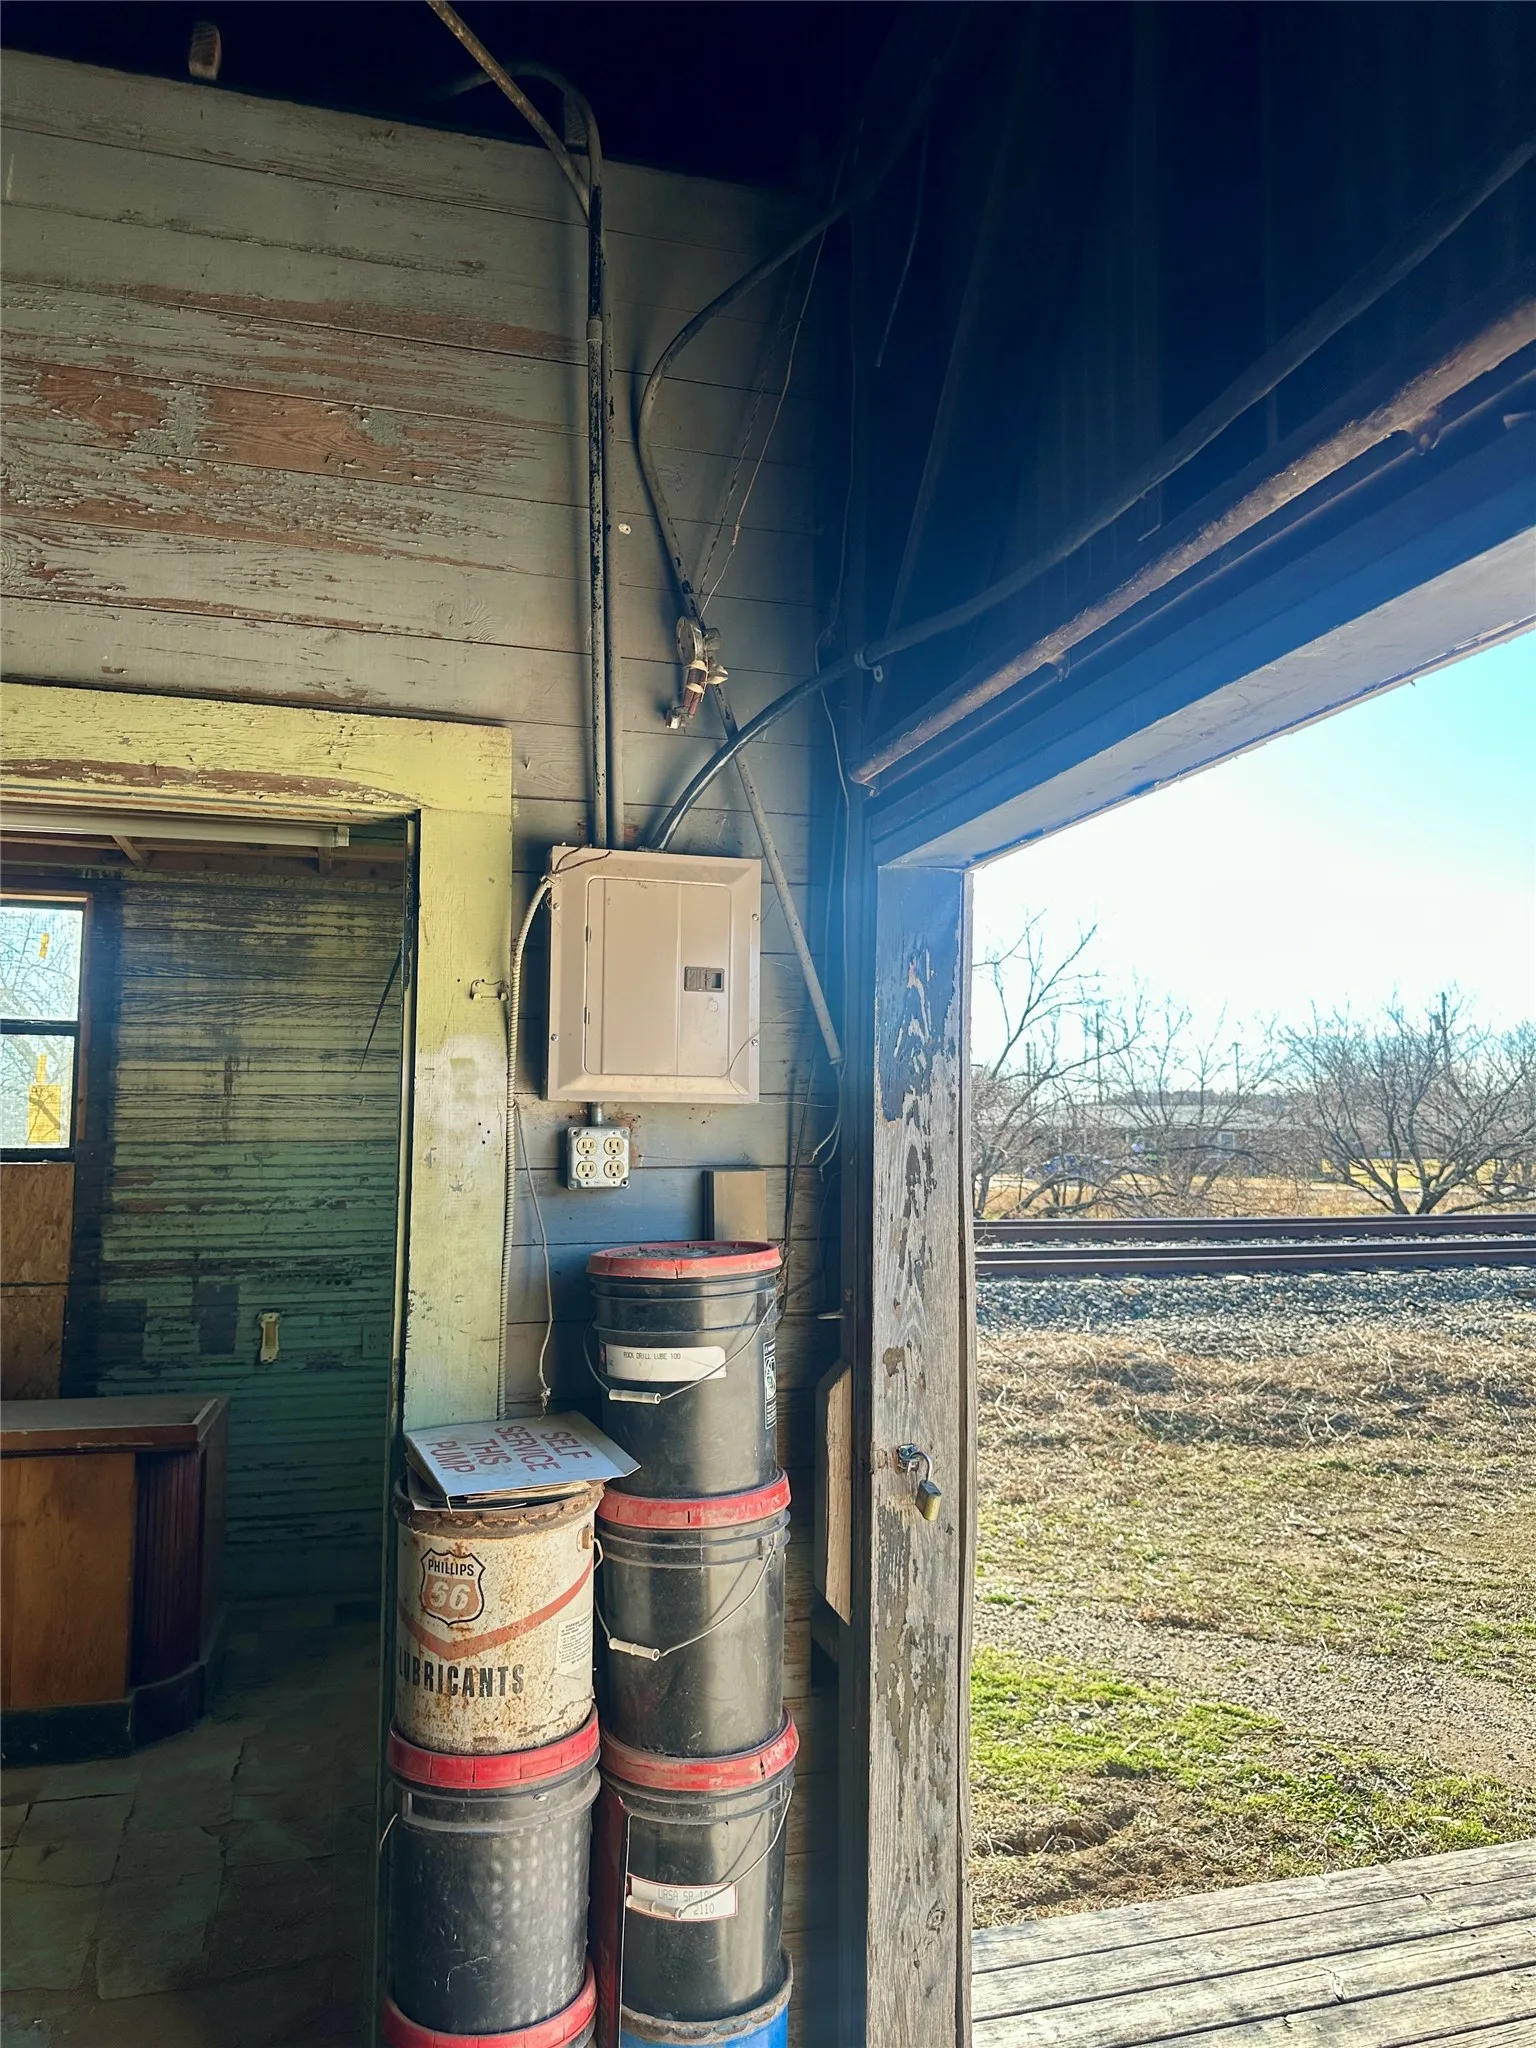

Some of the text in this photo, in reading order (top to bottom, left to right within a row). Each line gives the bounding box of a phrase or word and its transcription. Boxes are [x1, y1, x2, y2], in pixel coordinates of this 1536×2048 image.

[636, 1352, 651, 1360] DRILL
[653, 1352, 667, 1360] LUBE
[671, 1352, 681, 1360] 100
[426, 1440, 476, 1473] PUMP
[466, 1438, 512, 1465] THIS
[494, 1425, 561, 1472] SERVICE
[540, 1431, 592, 1460] SELF
[428, 1559, 474, 1577] PHILLIPS
[430, 1581, 471, 1610] 66
[400, 1646, 525, 1698] LUBRICANTS
[693, 1903, 715, 1915] 2110
